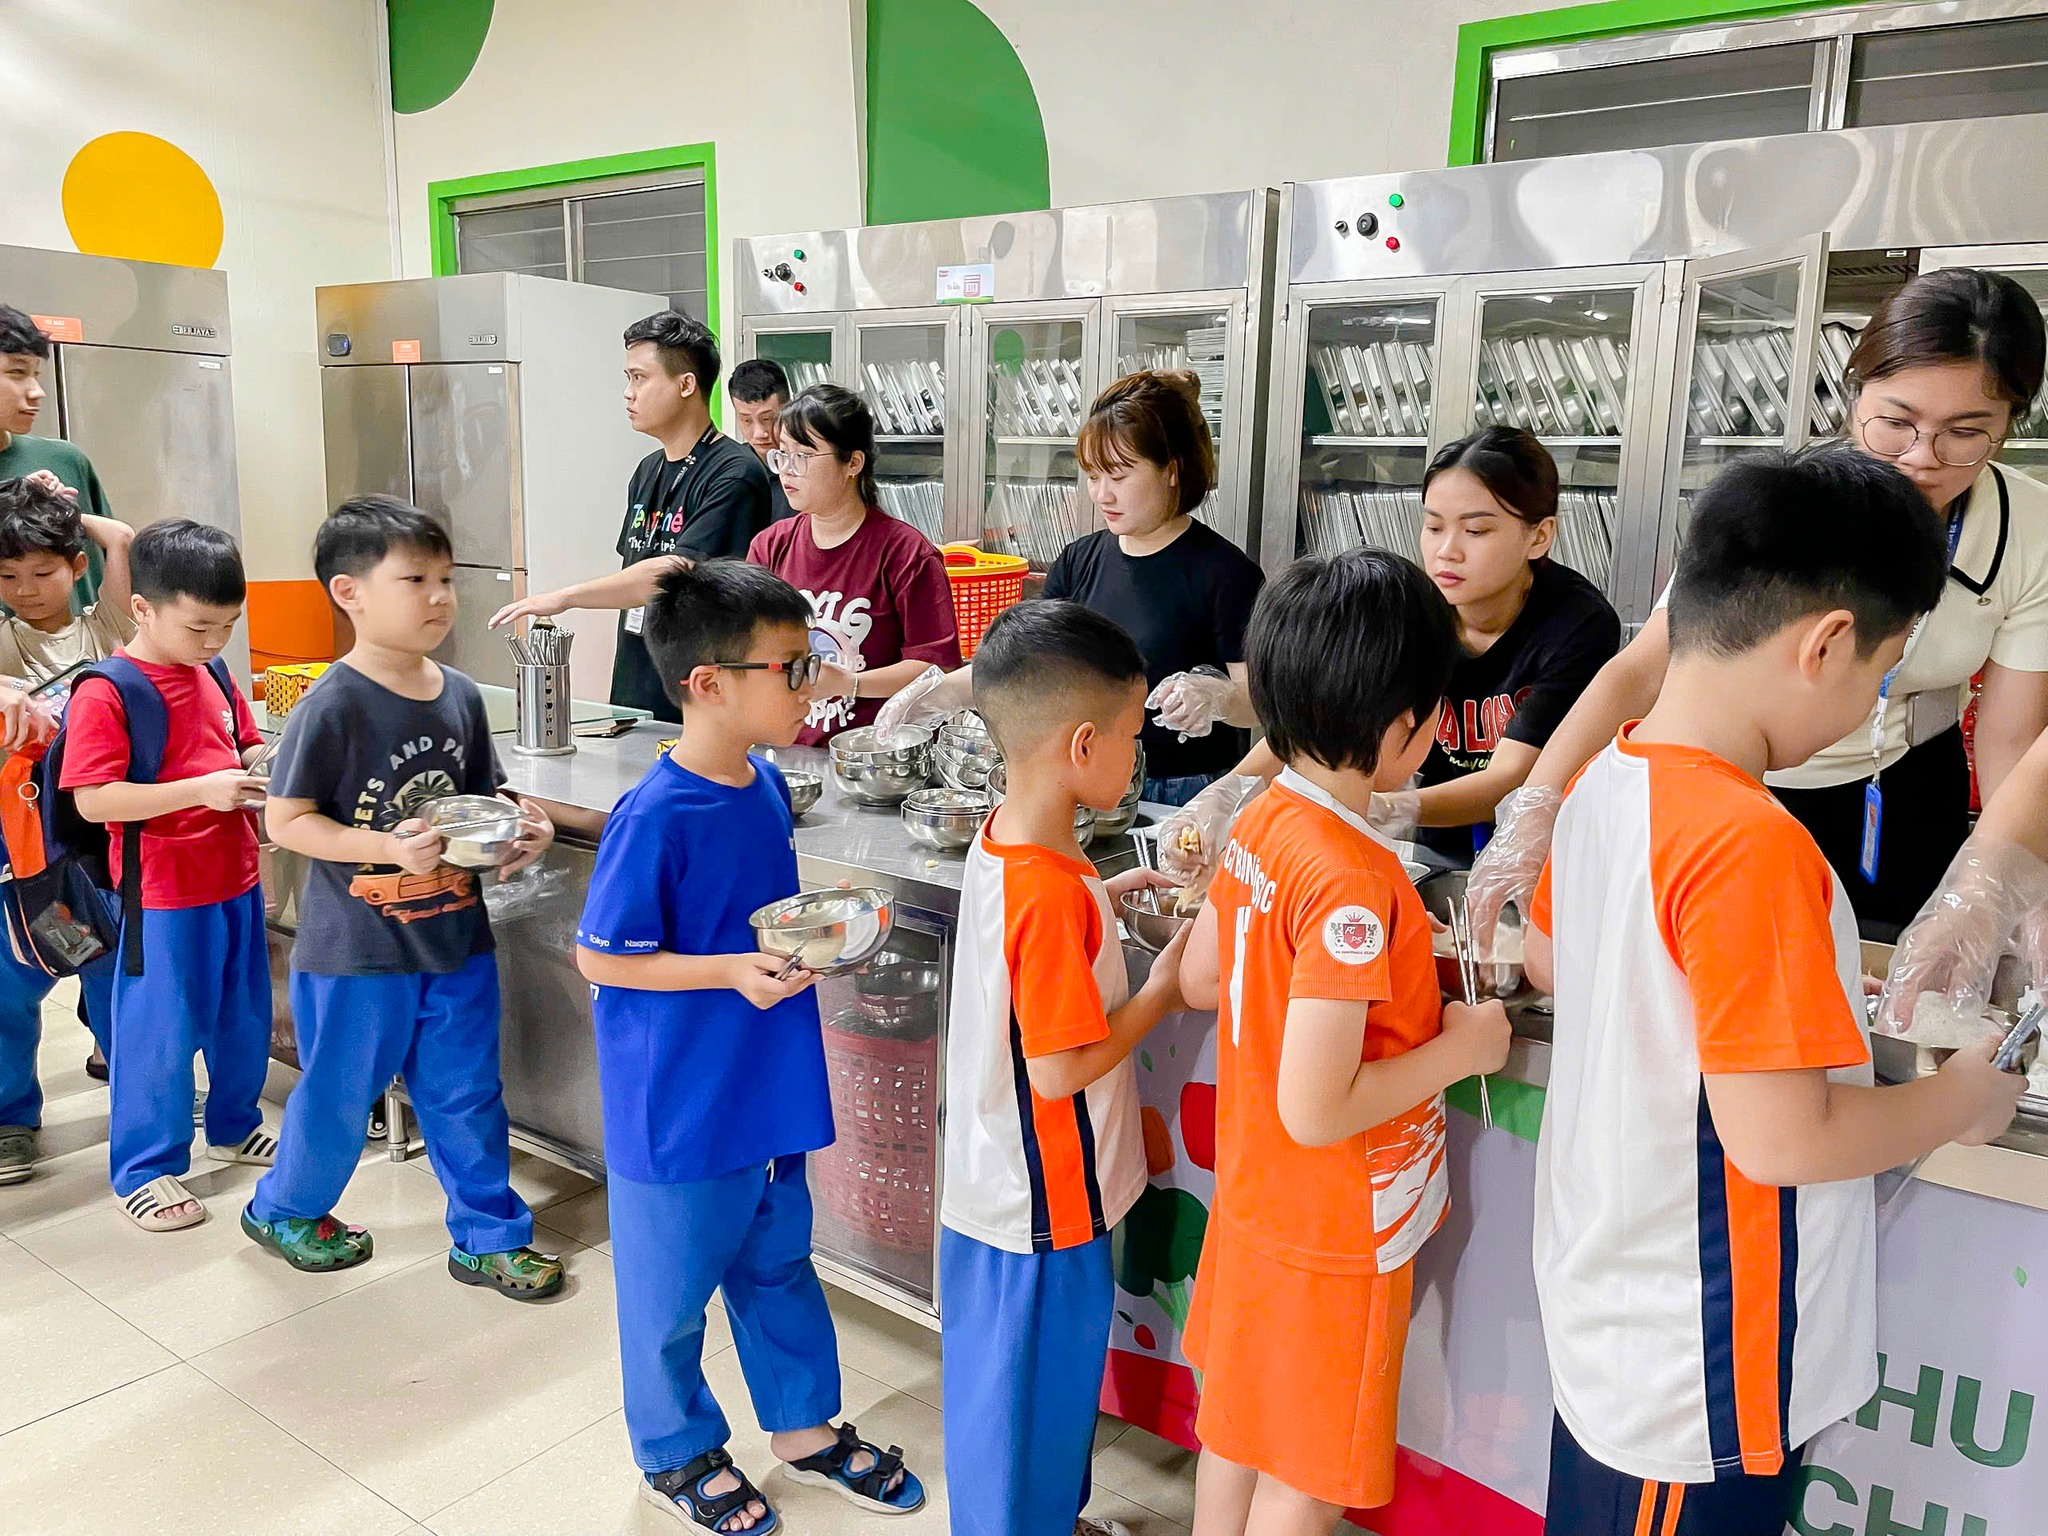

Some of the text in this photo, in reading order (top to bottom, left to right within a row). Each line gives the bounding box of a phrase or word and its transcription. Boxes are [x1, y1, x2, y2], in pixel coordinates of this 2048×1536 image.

[177, 325, 212, 337] BERJAYA
[389, 736, 433, 771] AND
[589, 933, 610, 947] Tokyo
[624, 940, 659, 948] Nagoya
[1840, 1351, 2036, 1468] HU
